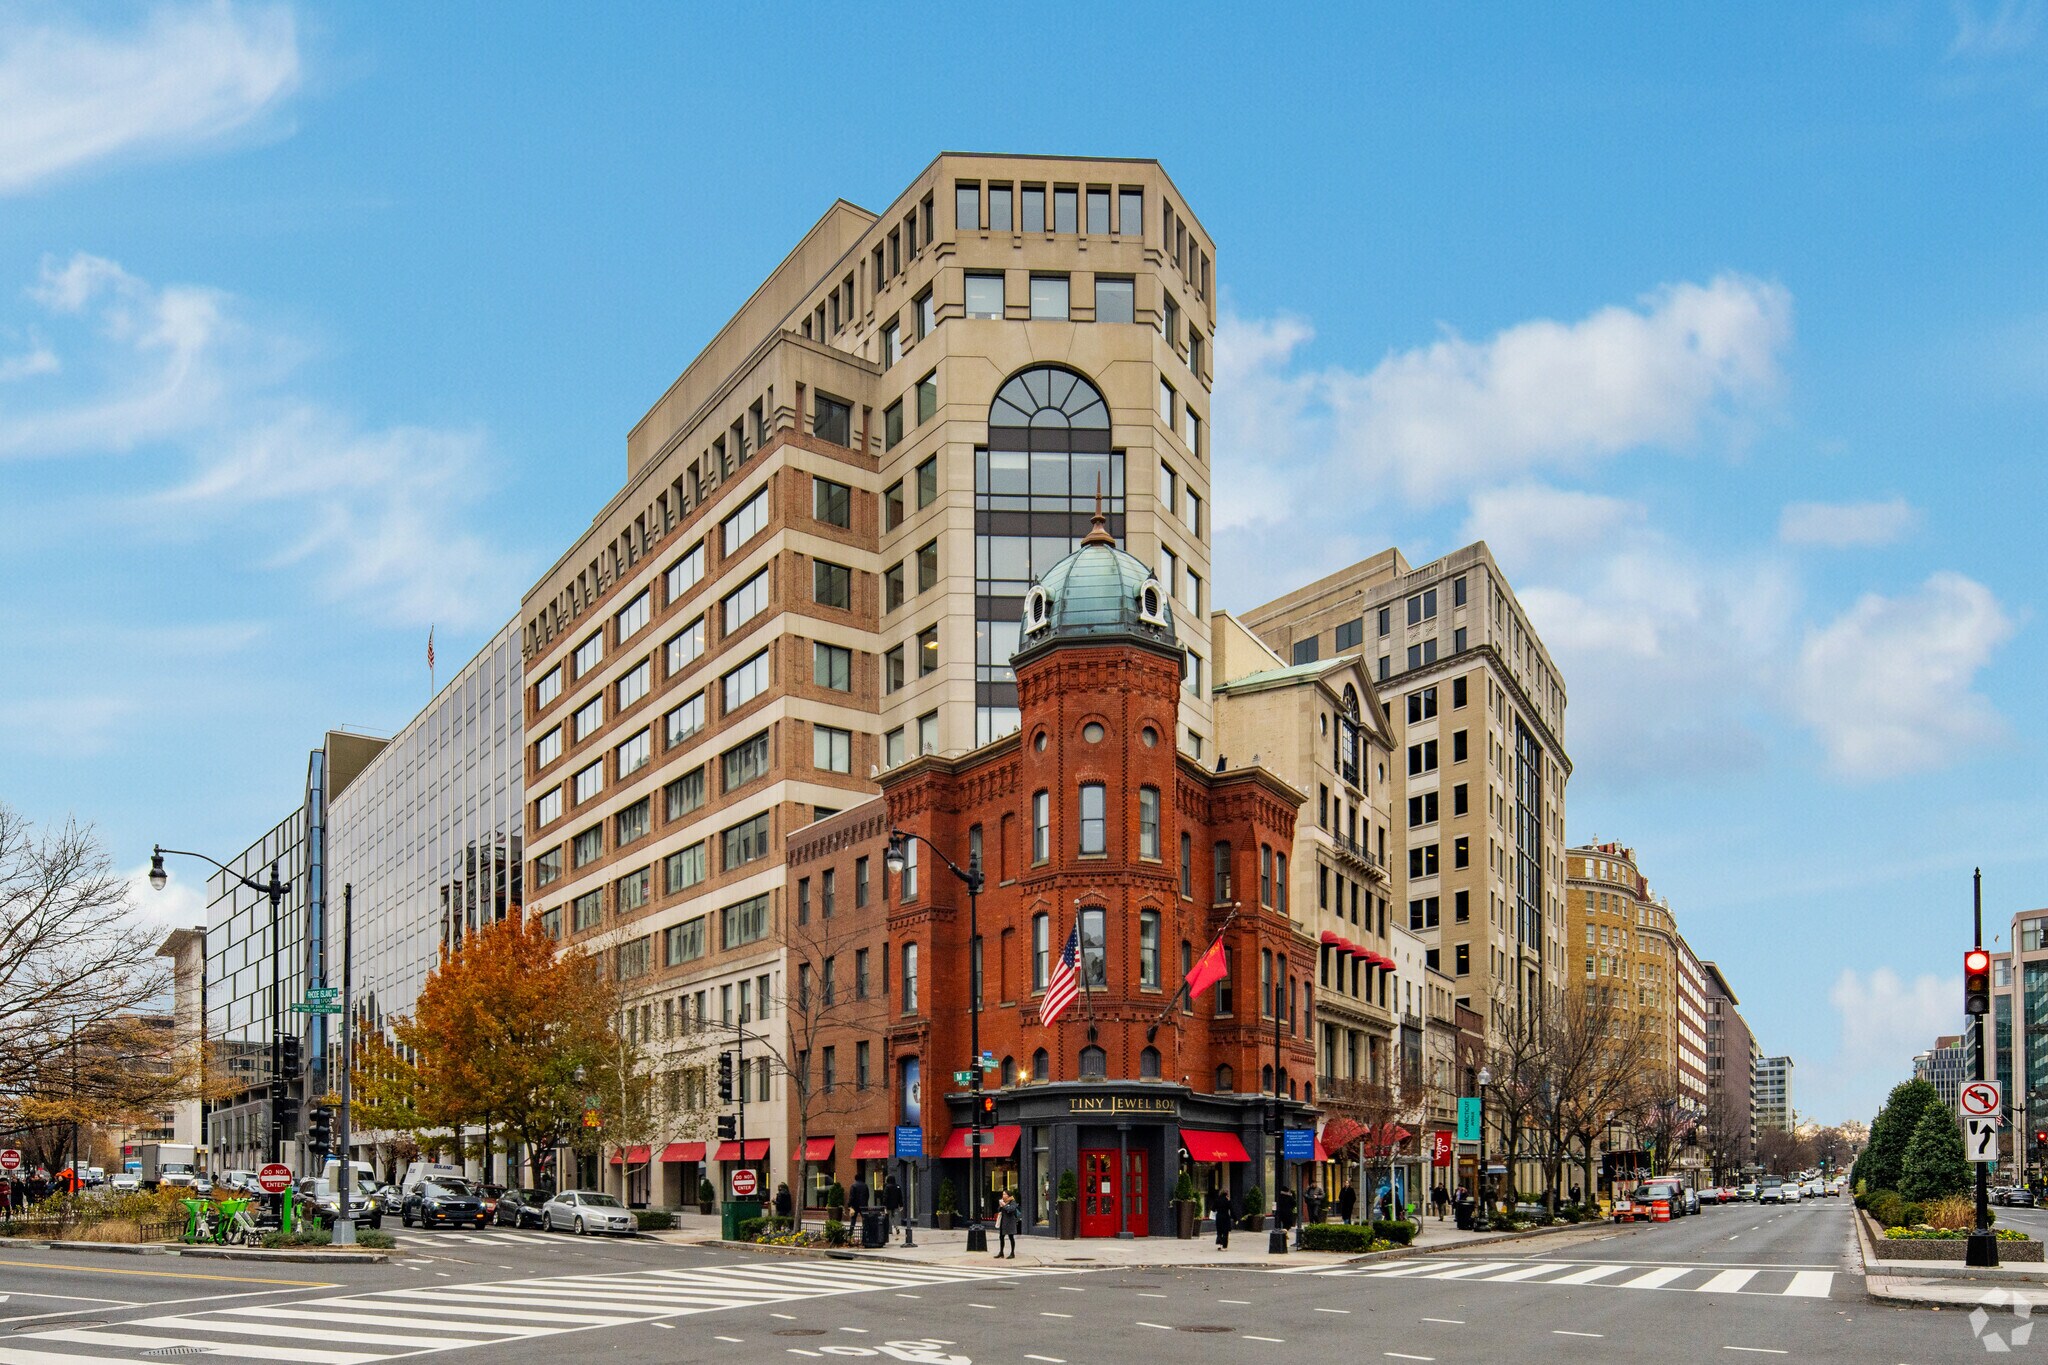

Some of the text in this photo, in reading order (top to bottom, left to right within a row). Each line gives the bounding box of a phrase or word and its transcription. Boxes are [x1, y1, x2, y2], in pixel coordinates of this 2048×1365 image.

[307, 990, 332, 998] RHODE ISLAND
[1070, 1096, 1176, 1116] TINY JEWEL BOX
